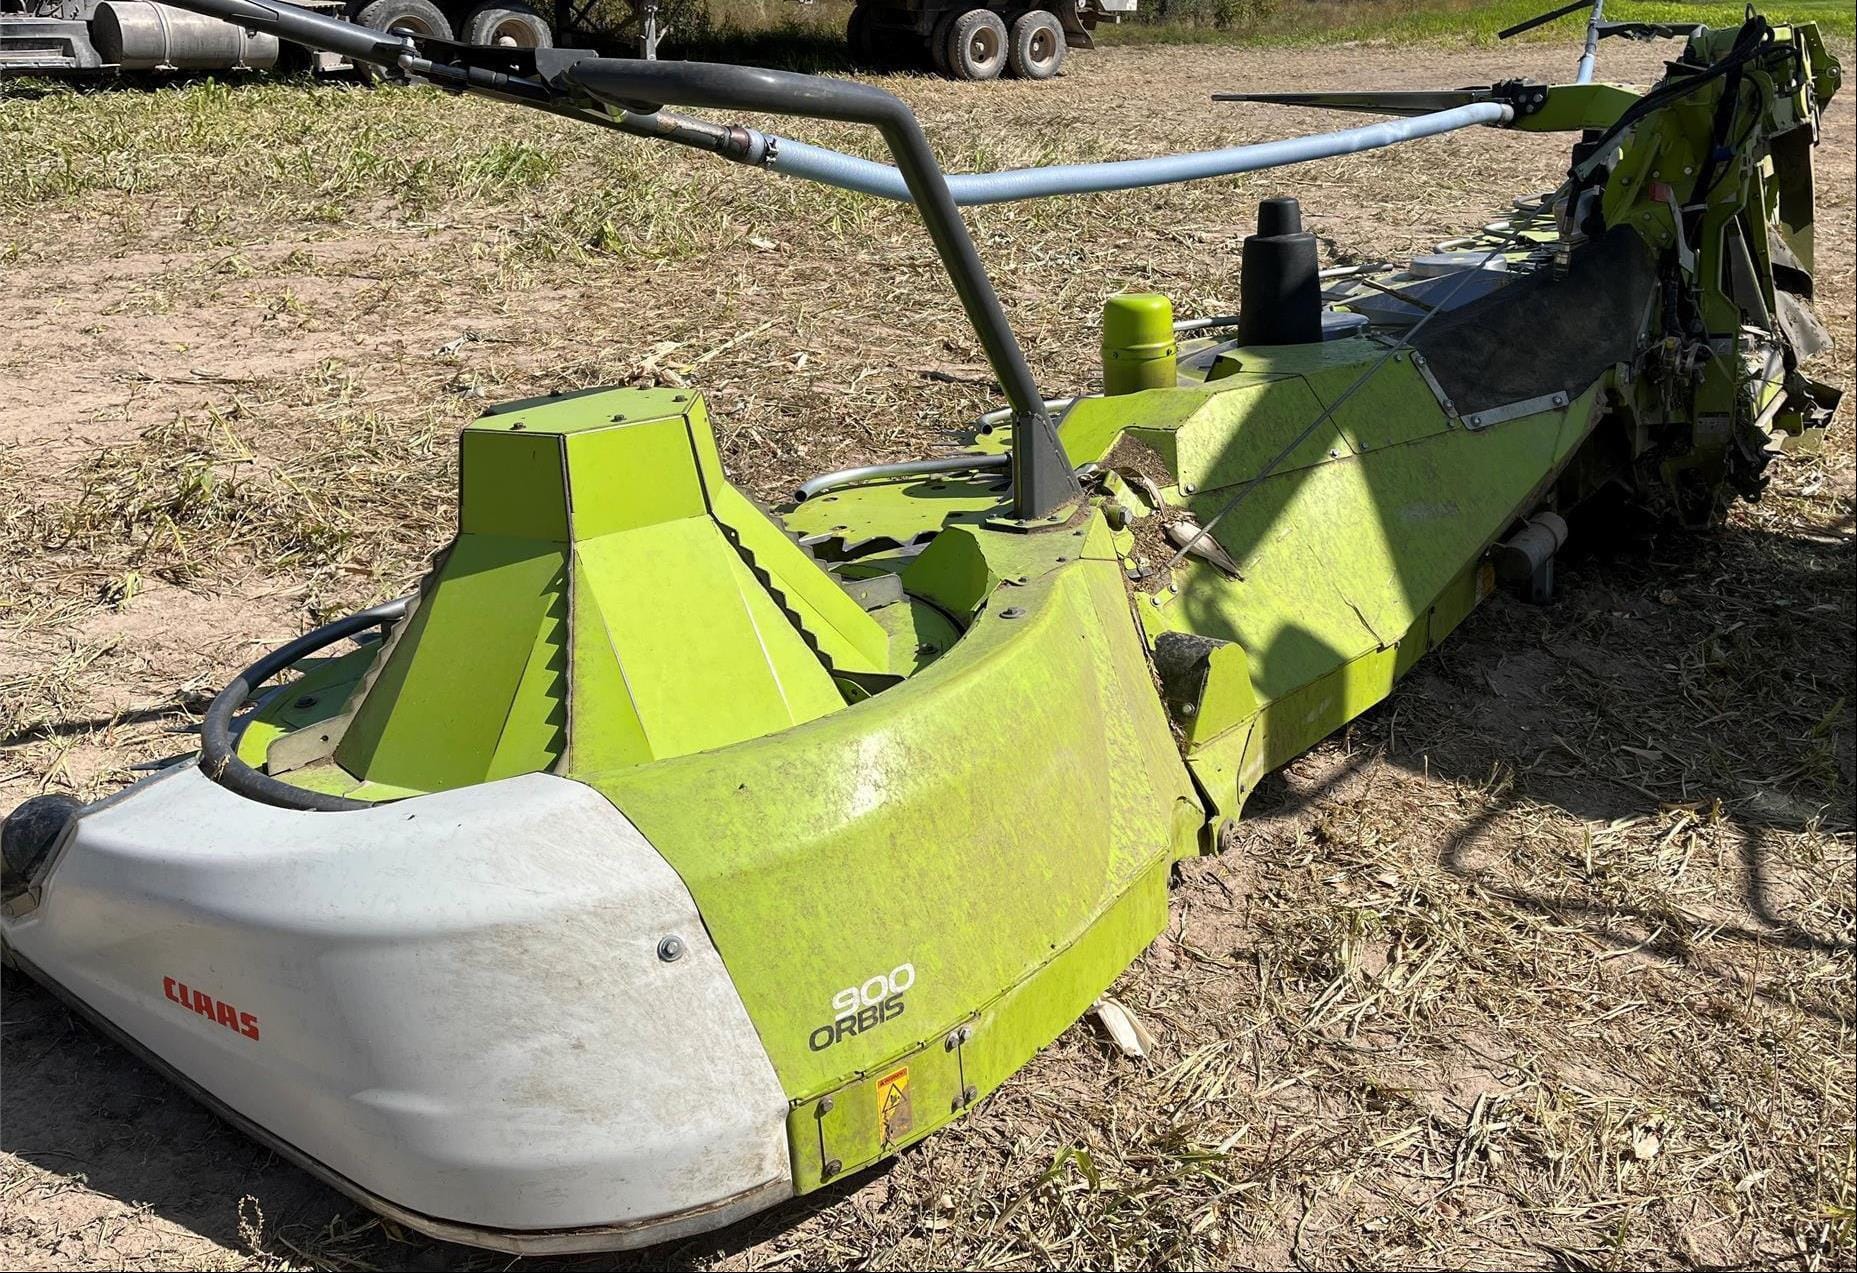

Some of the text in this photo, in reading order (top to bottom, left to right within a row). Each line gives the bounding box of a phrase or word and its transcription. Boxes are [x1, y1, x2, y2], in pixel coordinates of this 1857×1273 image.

[163, 976, 259, 1041] CLAAS
[809, 992, 905, 1052] ORBIS
[833, 963, 915, 1021] 900
